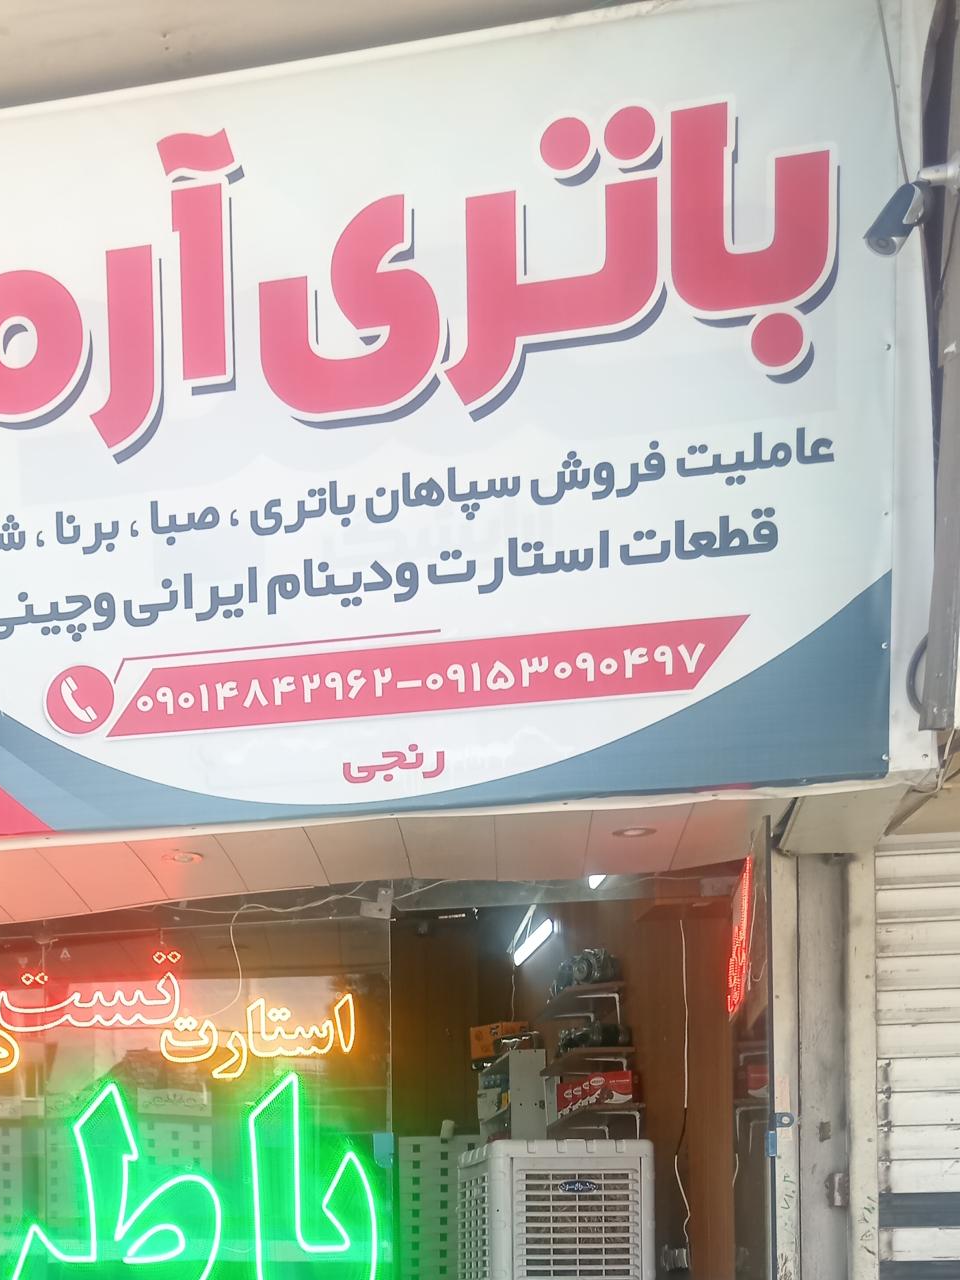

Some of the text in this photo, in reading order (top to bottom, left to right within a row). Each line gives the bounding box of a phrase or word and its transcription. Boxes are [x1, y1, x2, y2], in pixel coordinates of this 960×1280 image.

[259, 101, 832, 414] باتری
[530, 440, 667, 504] فروش
[676, 427, 836, 487] عاملیت
[149, 499, 221, 546] صبا
[249, 480, 357, 536] باتری
[365, 467, 522, 521] سپاهان
[55, 508, 120, 556] برنا
[426, 529, 610, 595] استارت
[620, 507, 780, 565] قطعات
[124, 566, 258, 628] ایرانی
[160, 993, 356, 1079] استارت
